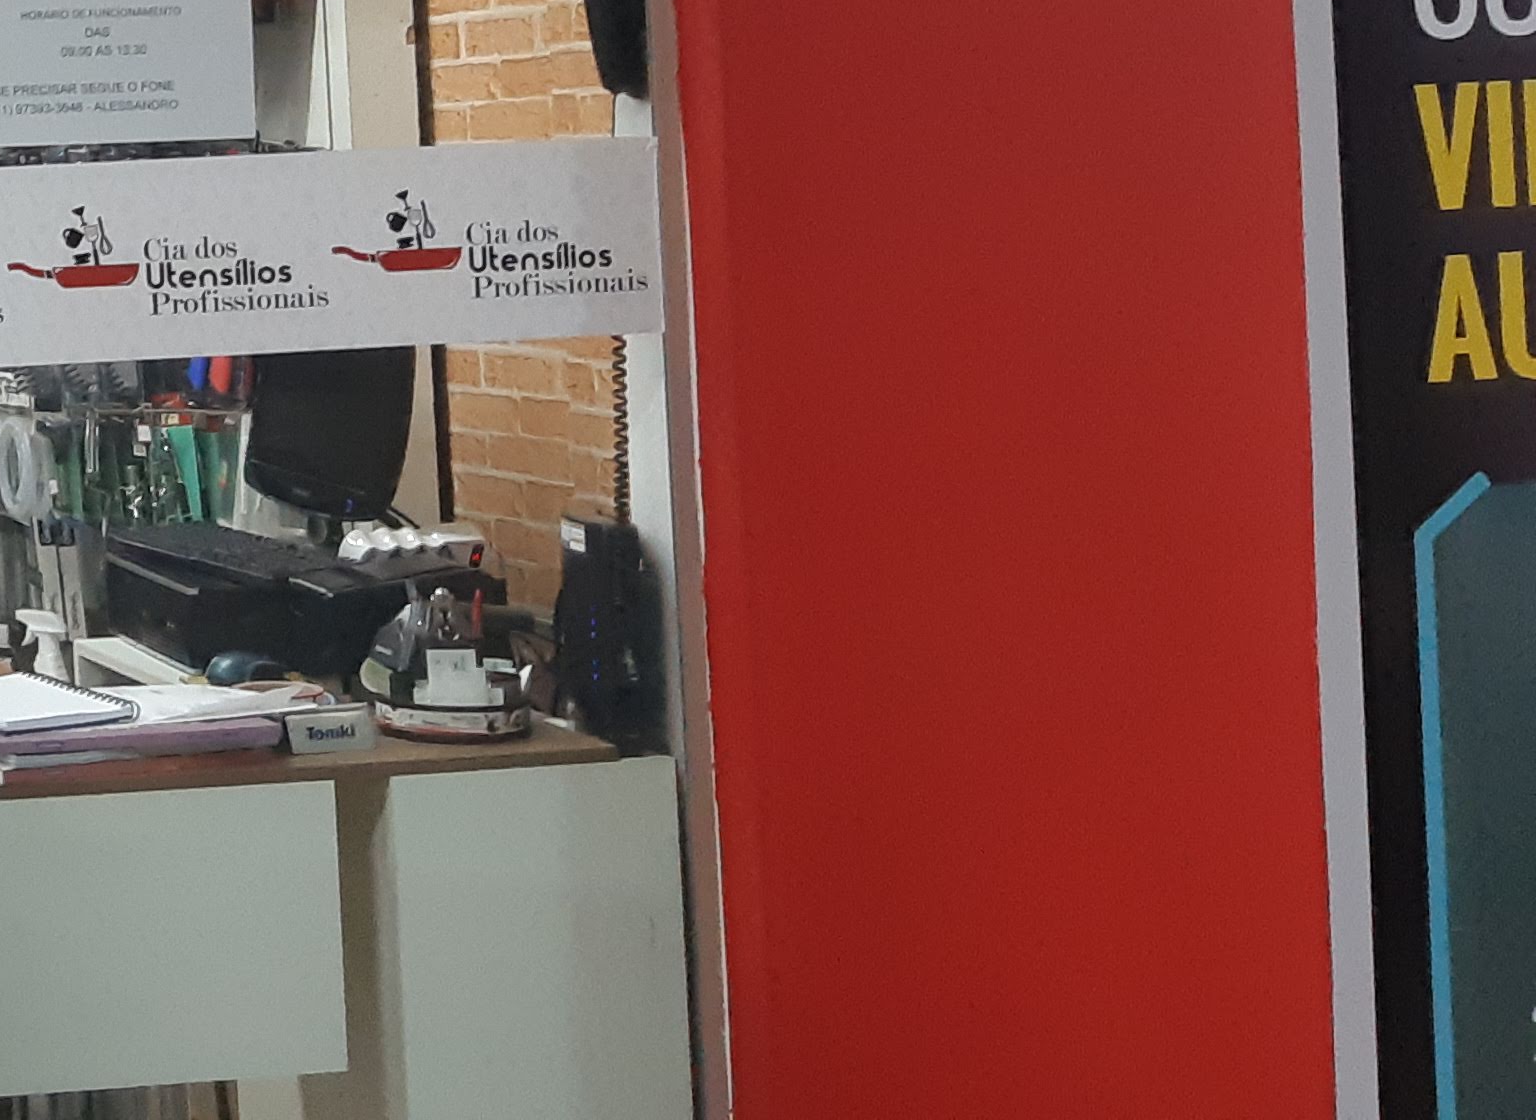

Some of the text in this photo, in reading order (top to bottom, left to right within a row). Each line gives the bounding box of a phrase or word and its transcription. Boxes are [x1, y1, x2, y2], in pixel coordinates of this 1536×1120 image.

[94, 100, 178, 111] ALESSANDRO
[466, 220, 559, 246] Cia dos
[144, 237, 238, 261] Cia dos
[468, 243, 612, 272] Utensílios
[146, 259, 292, 289] Utensílios
[471, 269, 649, 299] Profissionais
[150, 285, 329, 315] Profissionais
